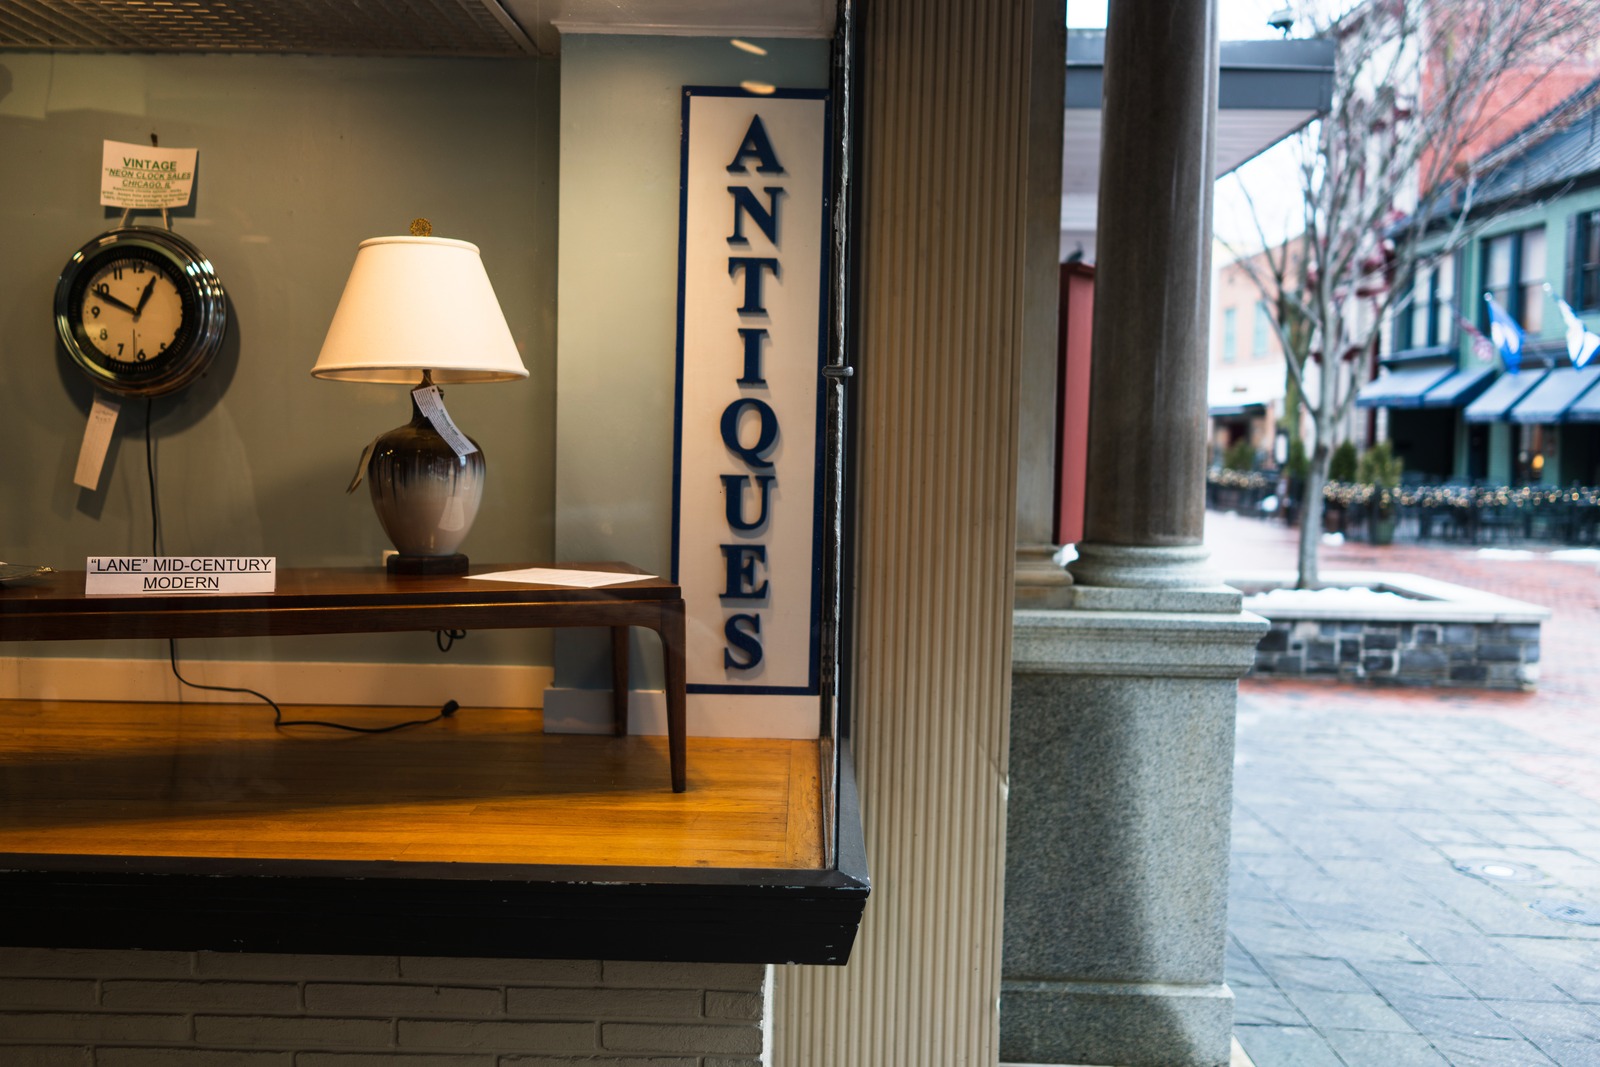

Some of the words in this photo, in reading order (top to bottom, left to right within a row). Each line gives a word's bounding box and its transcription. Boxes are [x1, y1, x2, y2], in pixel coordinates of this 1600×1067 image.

[123, 157, 177, 171] VINTAGE
[136, 171, 165, 180] CLOCK
[167, 172, 192, 180] SALES
[114, 267, 123, 280] 11
[133, 261, 145, 274] 12
[91, 306, 100, 319] 9
[99, 329, 108, 341] 8
[117, 343, 125, 356] 7
[136, 348, 147, 362] 6
[719, 114, 784, 670] ANTIQUES
[91, 558, 148, 572] “LANE”
[153, 558, 272, 572] MID-CENTURY
[143, 576, 219, 589] MODERN
